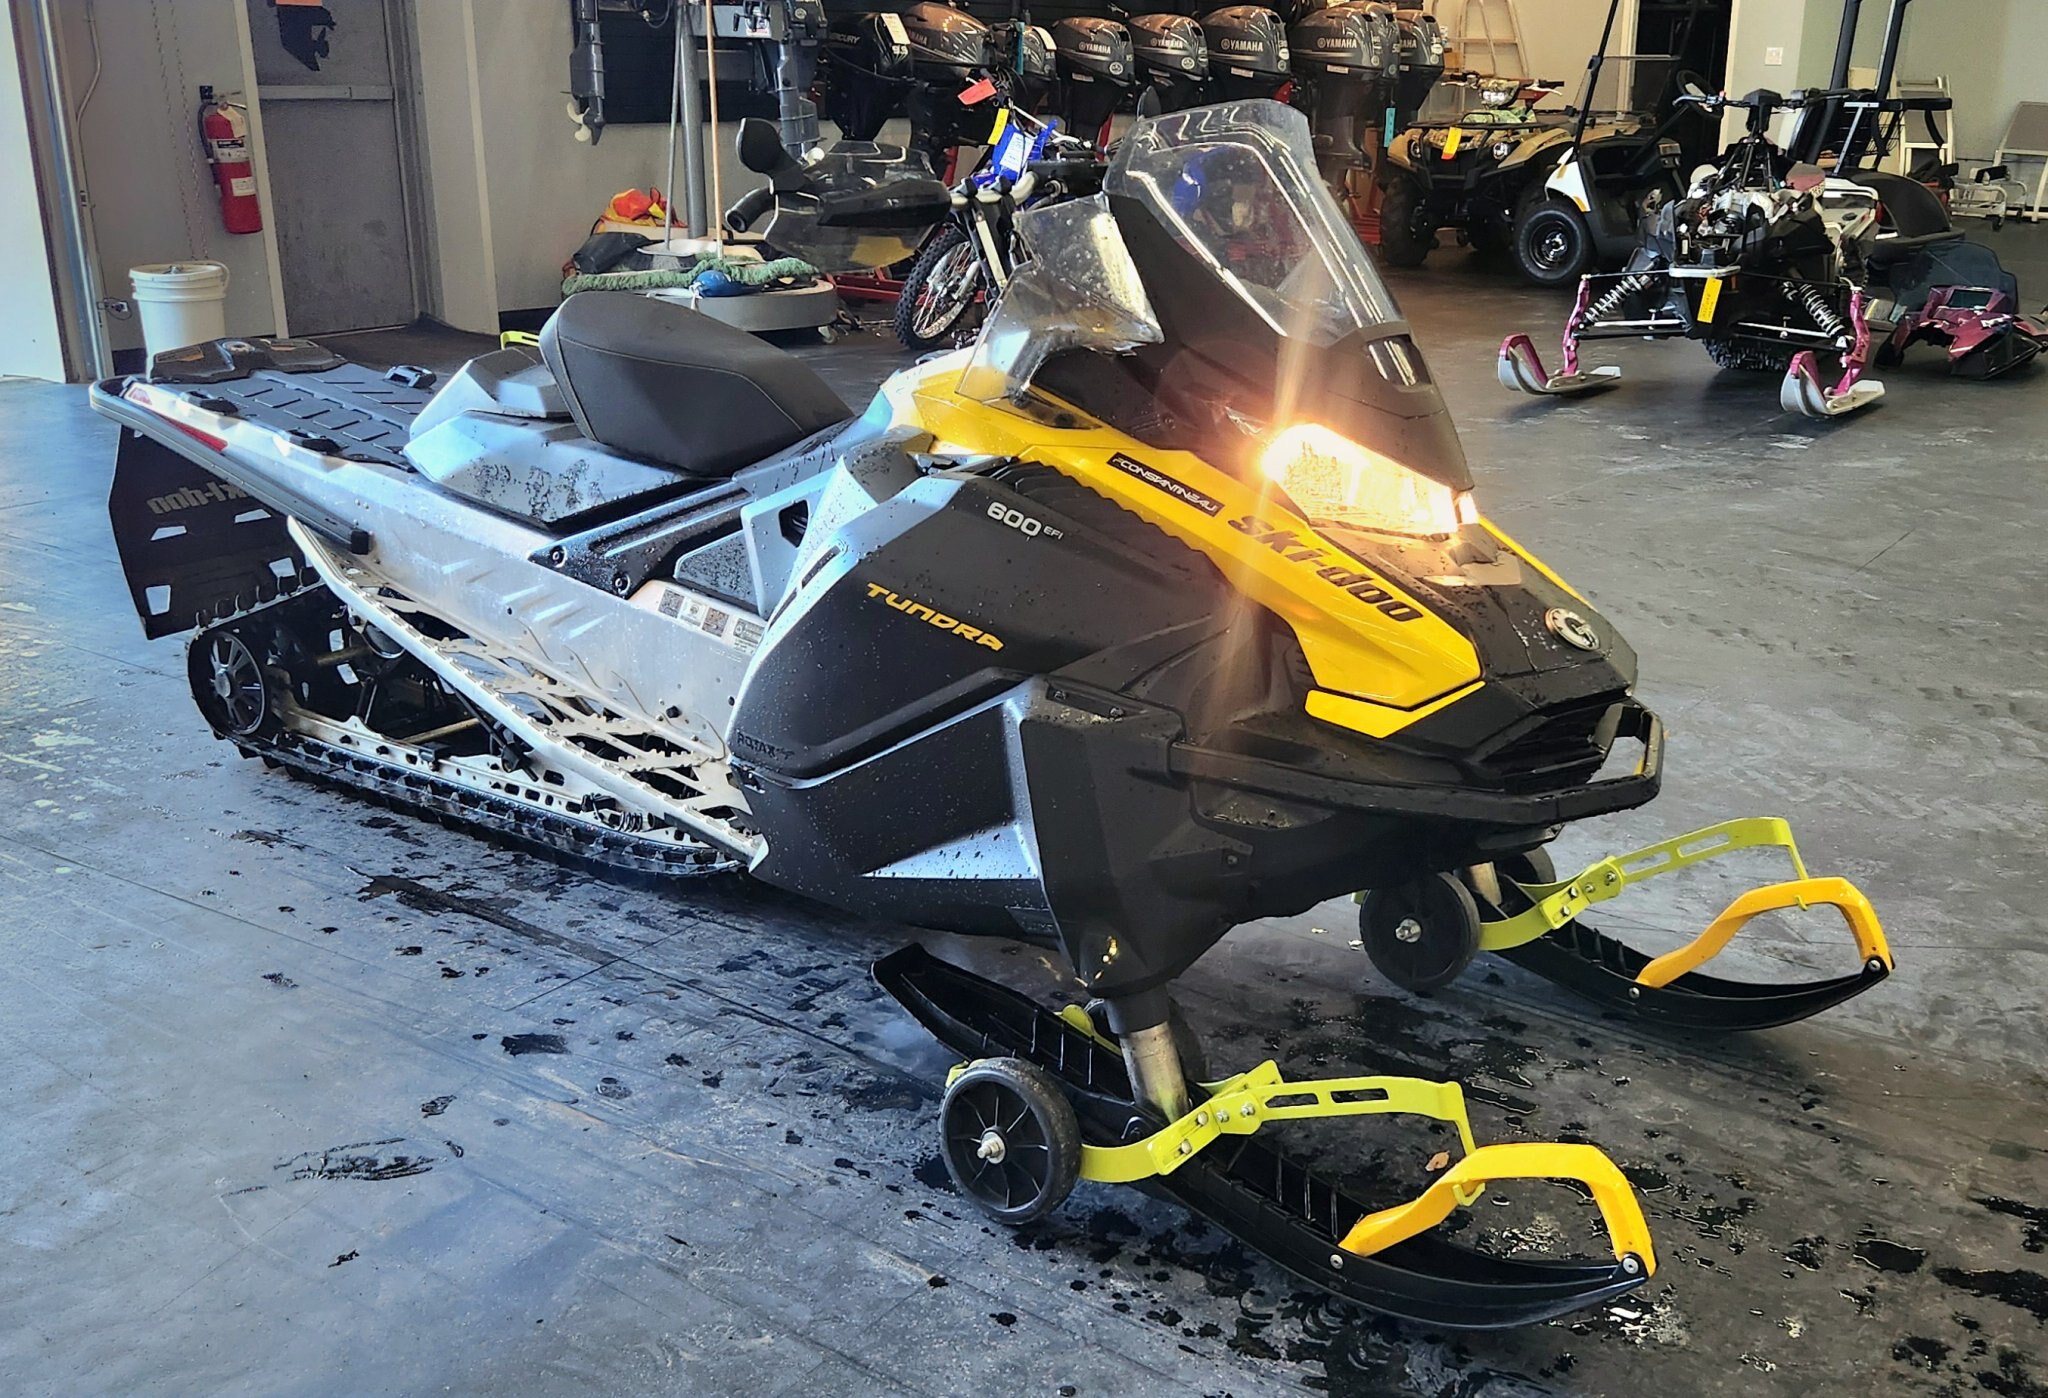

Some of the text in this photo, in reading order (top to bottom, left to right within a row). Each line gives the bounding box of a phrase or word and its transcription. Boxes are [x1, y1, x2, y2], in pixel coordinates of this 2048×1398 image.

[907, 31, 928, 46] AMAHA
[1157, 38, 1184, 49] YAMAHA
[1326, 38, 1358, 49] YAMAHA
[1400, 39, 1418, 49] AHA
[1085, 42, 1111, 55] YAMAHA
[1230, 40, 1264, 52] YAMAHA
[987, 502, 1064, 540] 600 EFI
[867, 582, 1004, 651] TUNDRA
